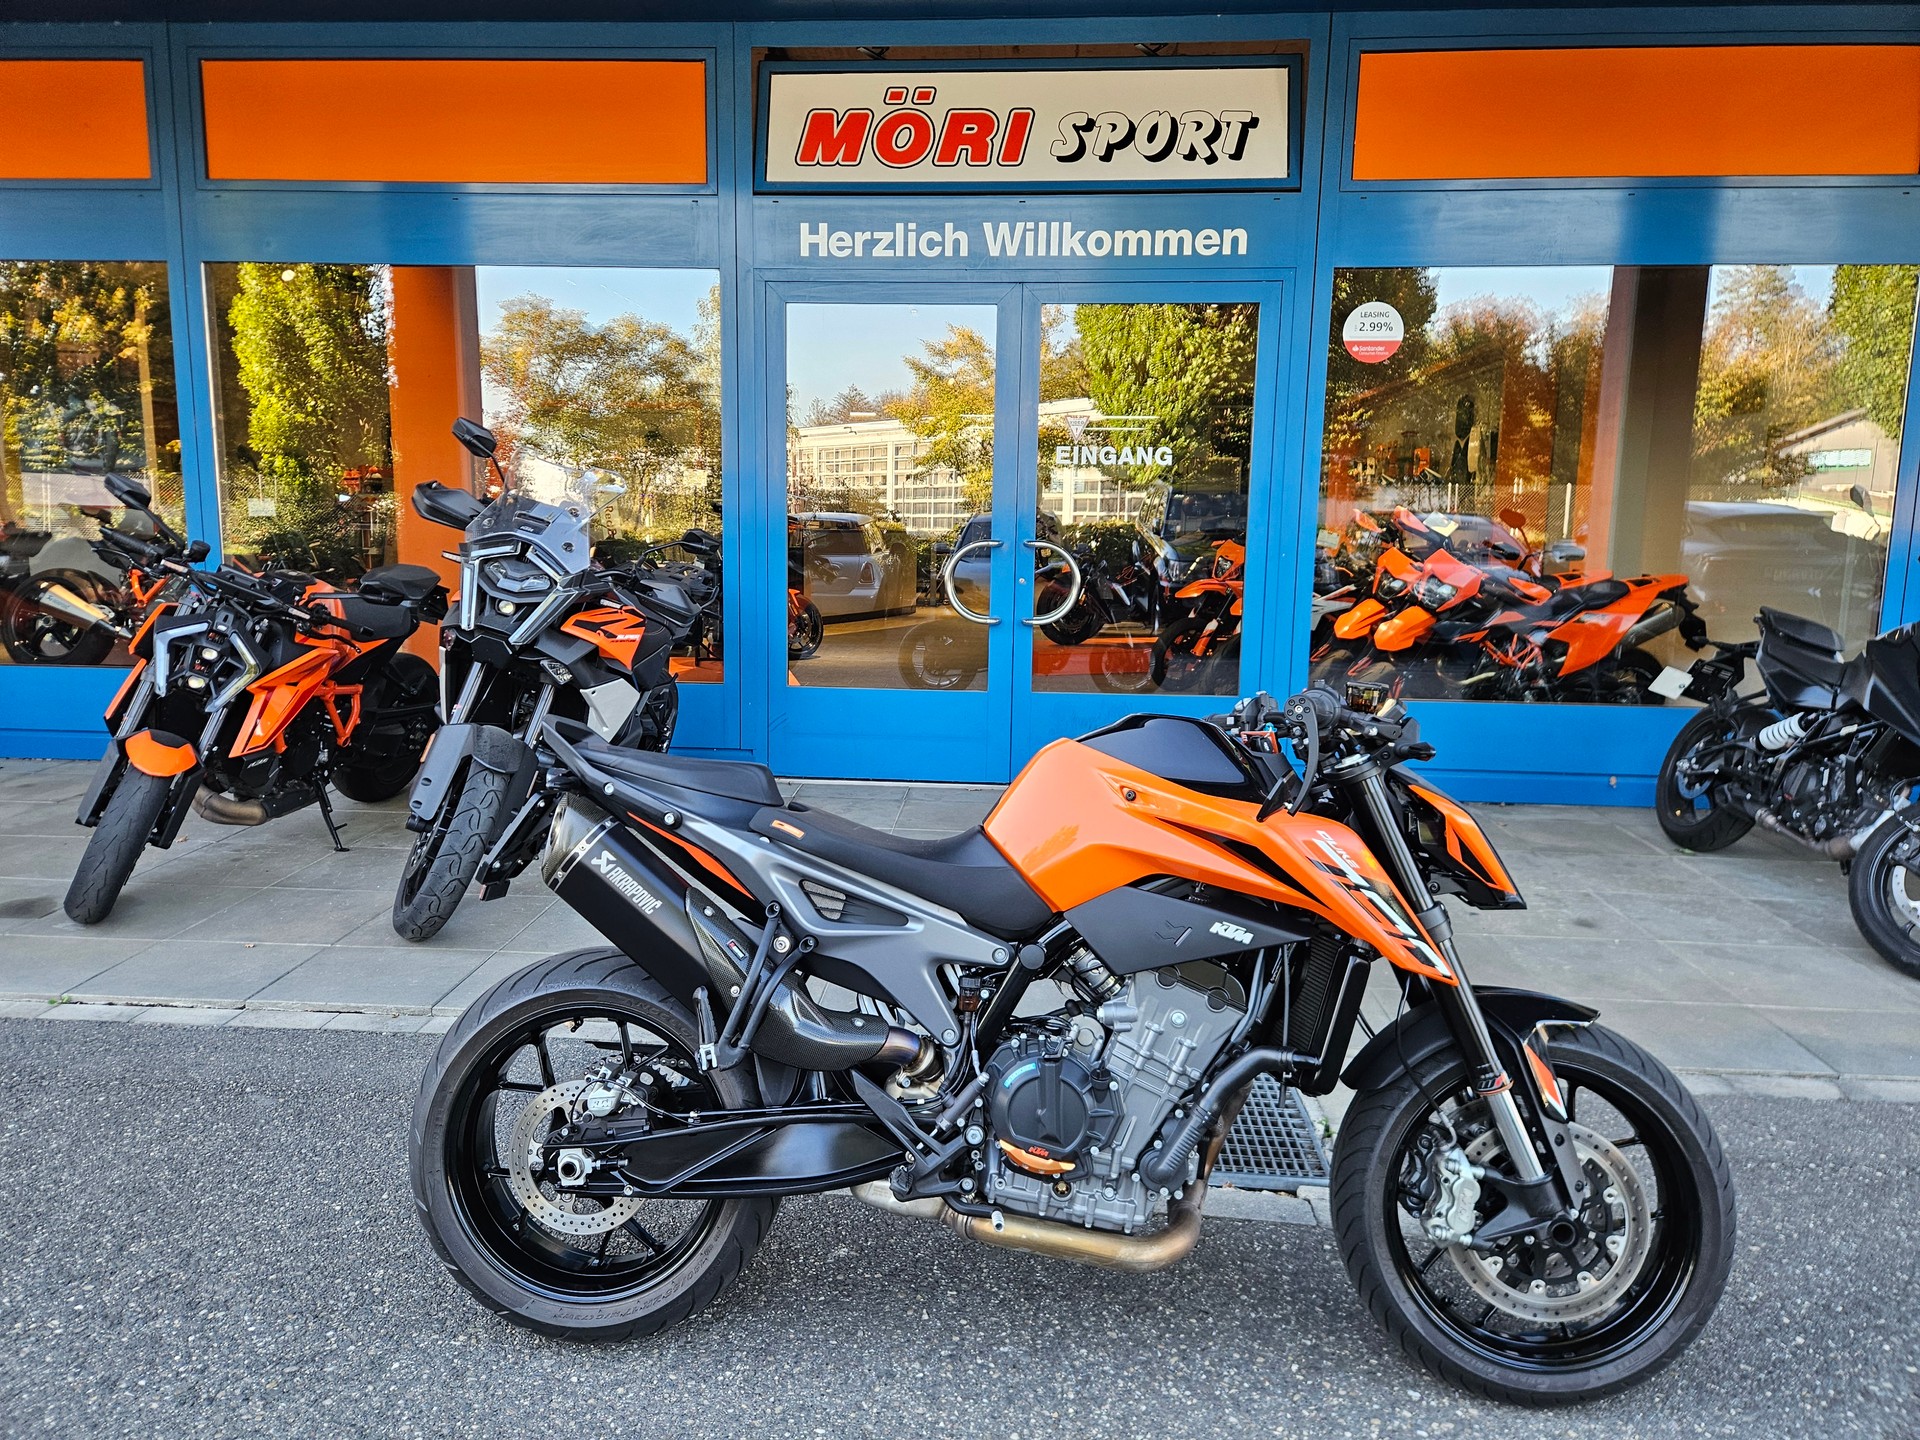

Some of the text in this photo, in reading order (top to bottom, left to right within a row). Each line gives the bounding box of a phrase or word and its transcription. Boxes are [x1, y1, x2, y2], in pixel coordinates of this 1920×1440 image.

[795, 86, 1260, 168] MÖRI SPORT
[800, 221, 1248, 257] Herzlich Willkommen
[1359, 322, 1394, 332] 2.99%
[1056, 446, 1173, 466] EINGANG
[1316, 830, 1361, 869] DUKE
[1209, 921, 1254, 945] KTM
[1028, 1146, 1049, 1157] KTM
